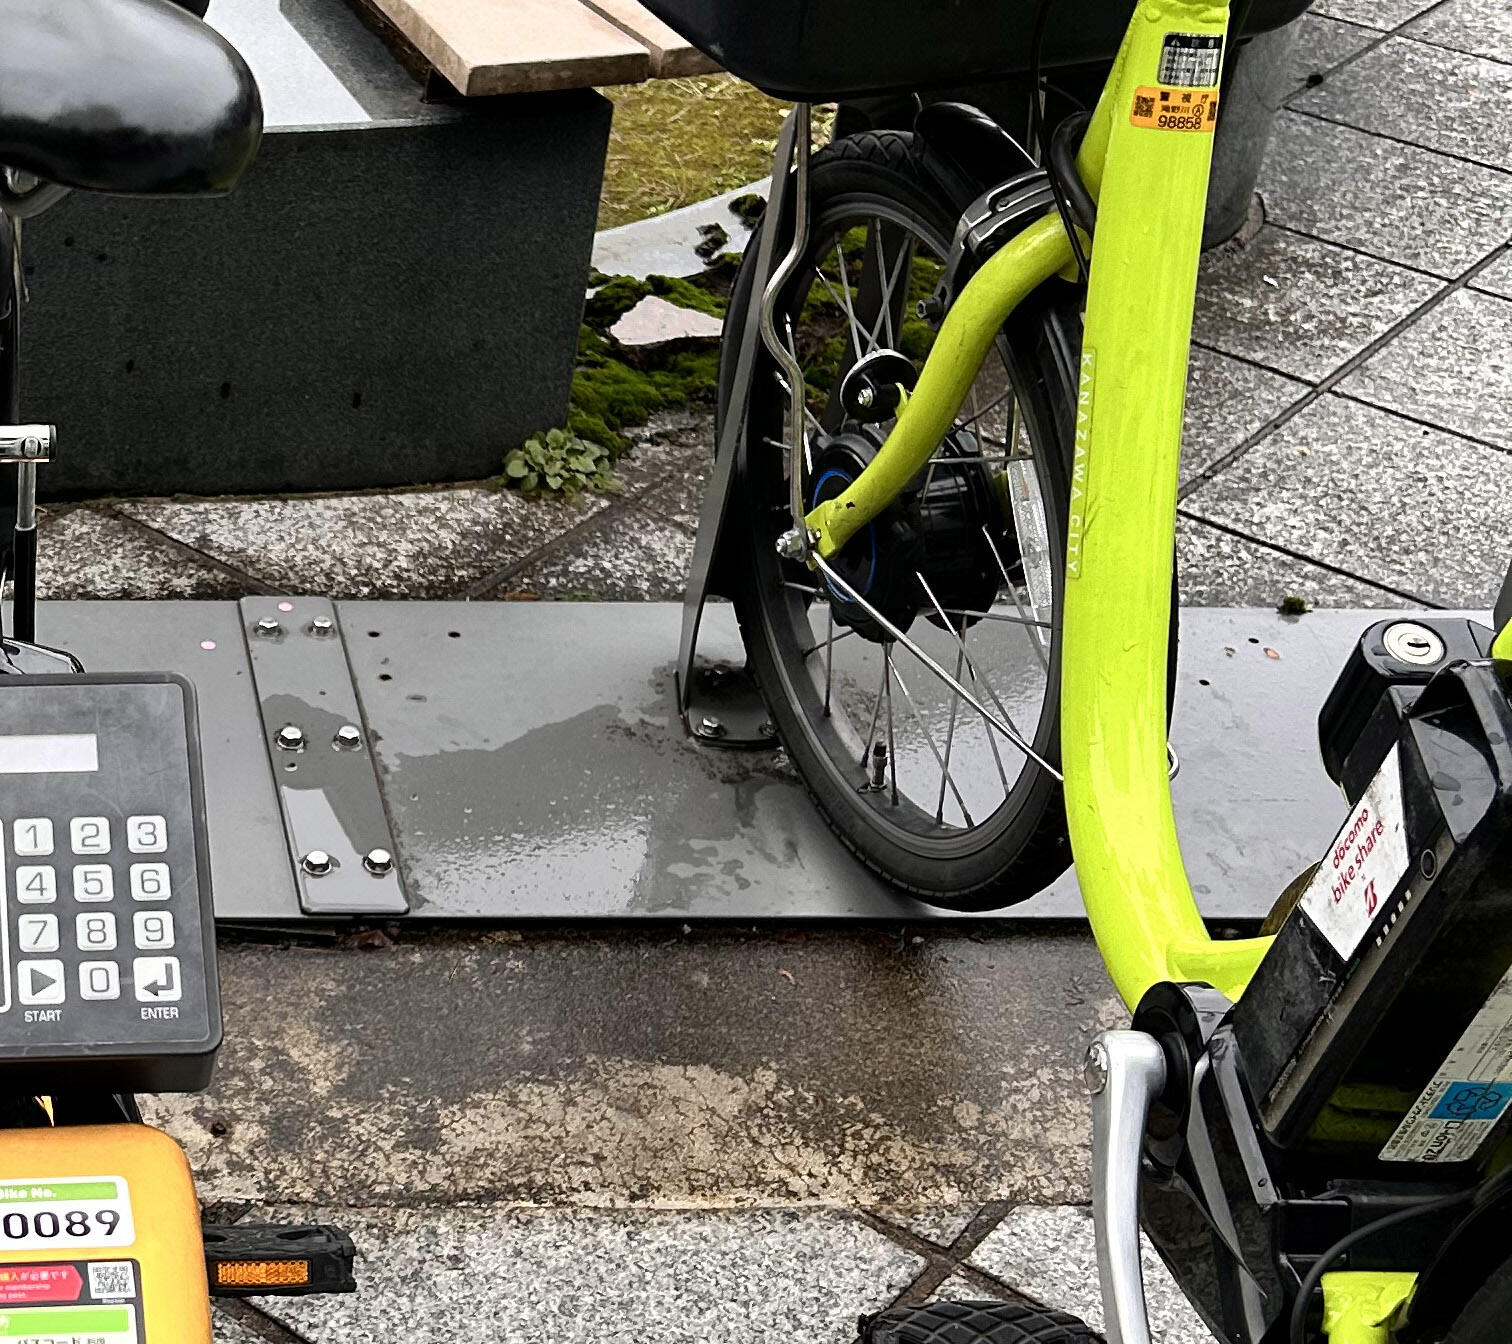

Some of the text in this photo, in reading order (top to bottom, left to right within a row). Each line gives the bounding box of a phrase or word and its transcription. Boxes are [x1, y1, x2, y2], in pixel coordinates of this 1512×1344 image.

[1067, 352, 1093, 573] KANAZAWA CITY
[26, 821, 157, 849] 1 2 3
[1332, 808, 1369, 869] docomo
[1331, 820, 1384, 904] bike share
[25, 868, 161, 897] 4 5 6
[27, 916, 165, 946] 7 8 9
[89, 966, 111, 994] 0
[24, 1009, 62, 1023] START
[140, 1006, 180, 1020] ENTER
[2, 1209, 121, 1240] 0089
